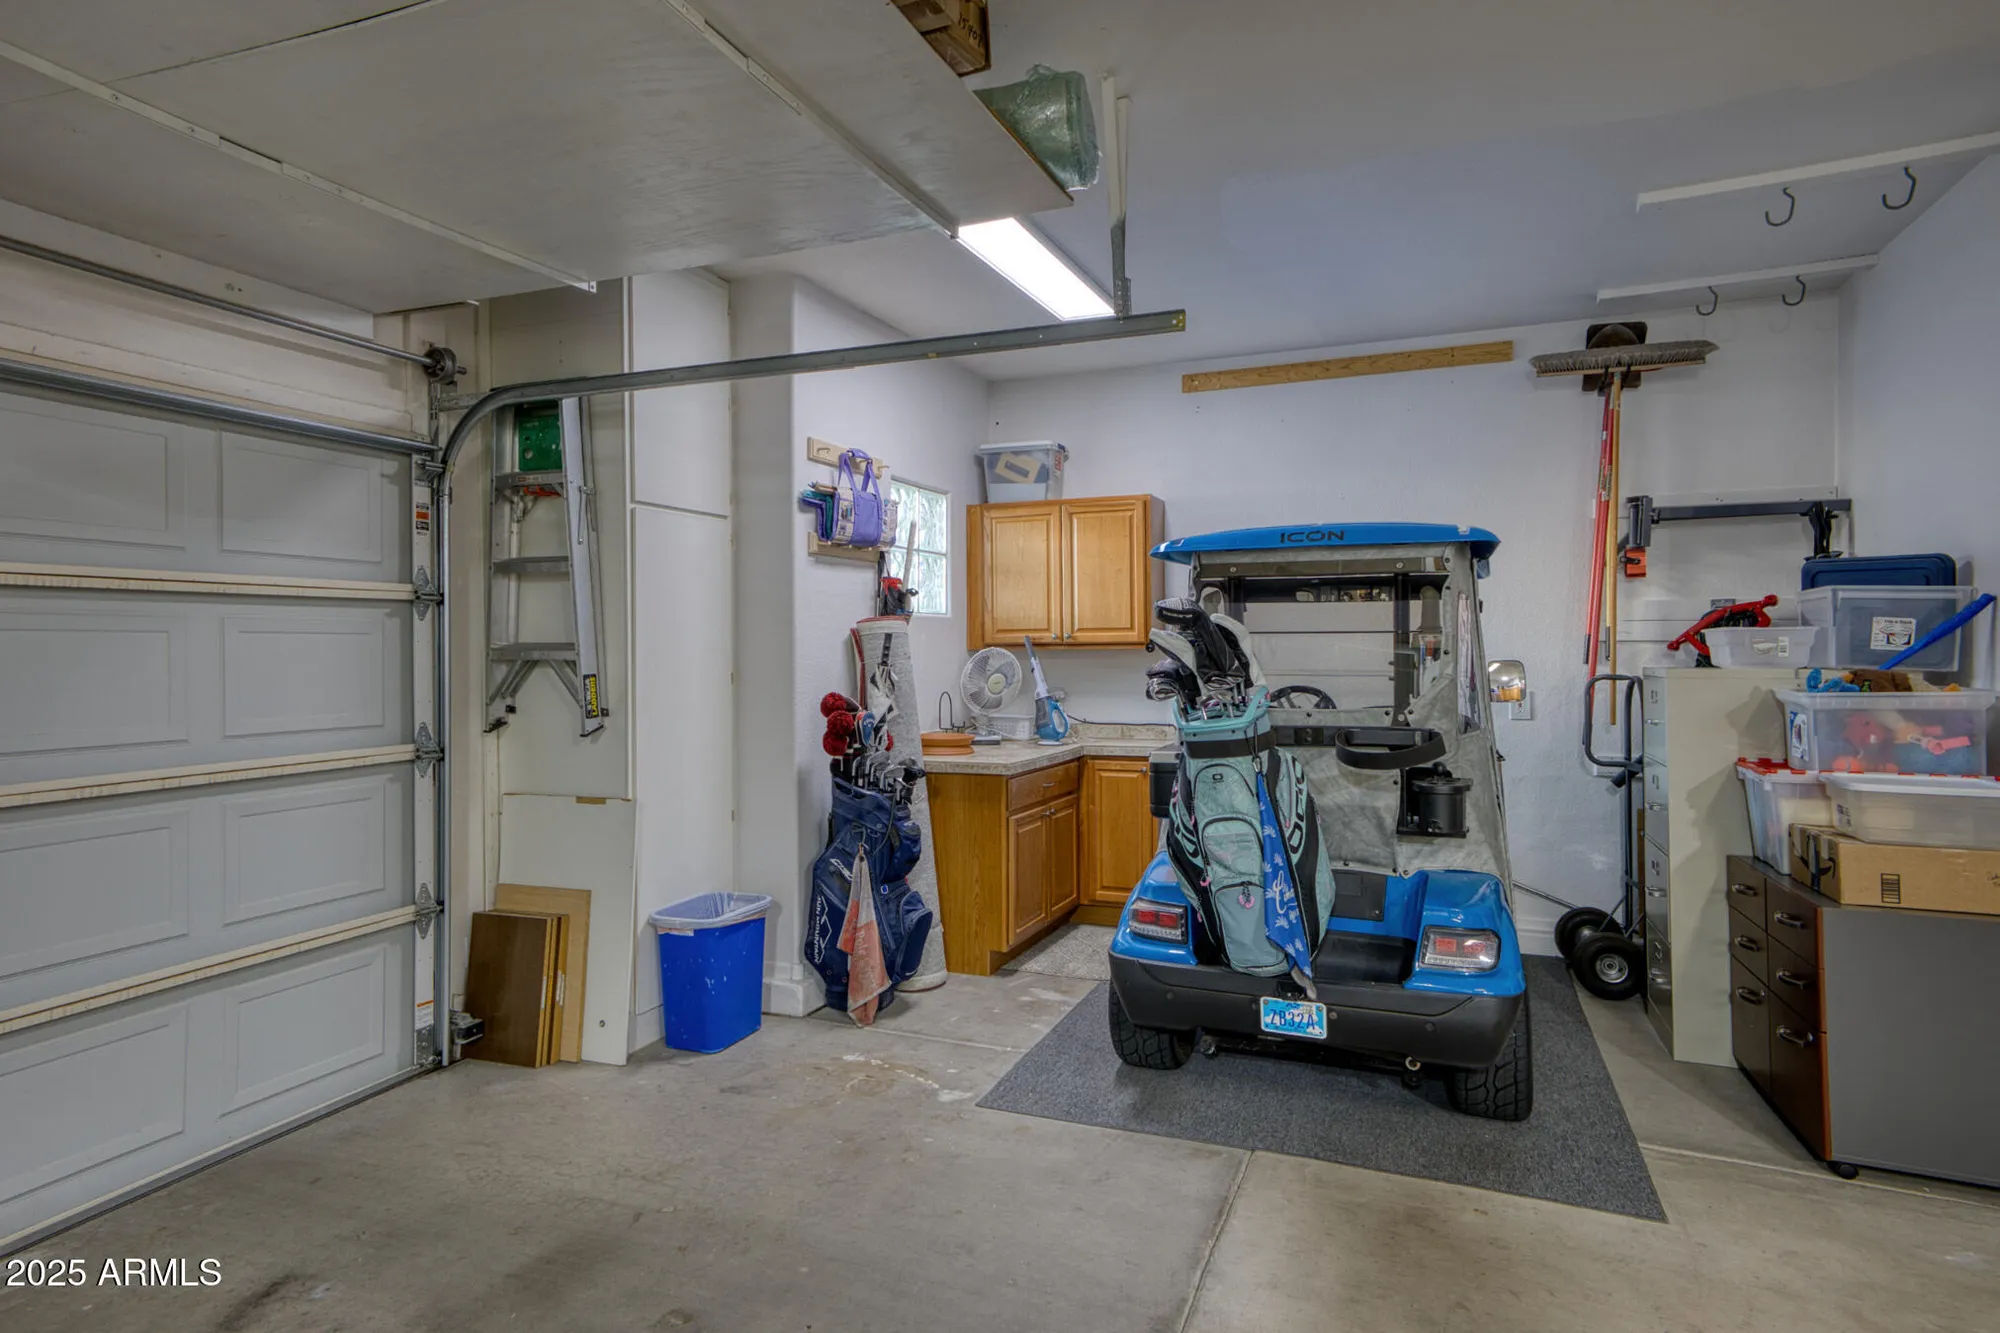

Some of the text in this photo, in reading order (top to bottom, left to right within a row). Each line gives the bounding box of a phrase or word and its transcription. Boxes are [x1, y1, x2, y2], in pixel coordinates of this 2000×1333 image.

[1280, 530, 1344, 544] ICON
[590, 676, 598, 716] LADDERS
[1269, 1008, 1315, 1031] ZB32A
